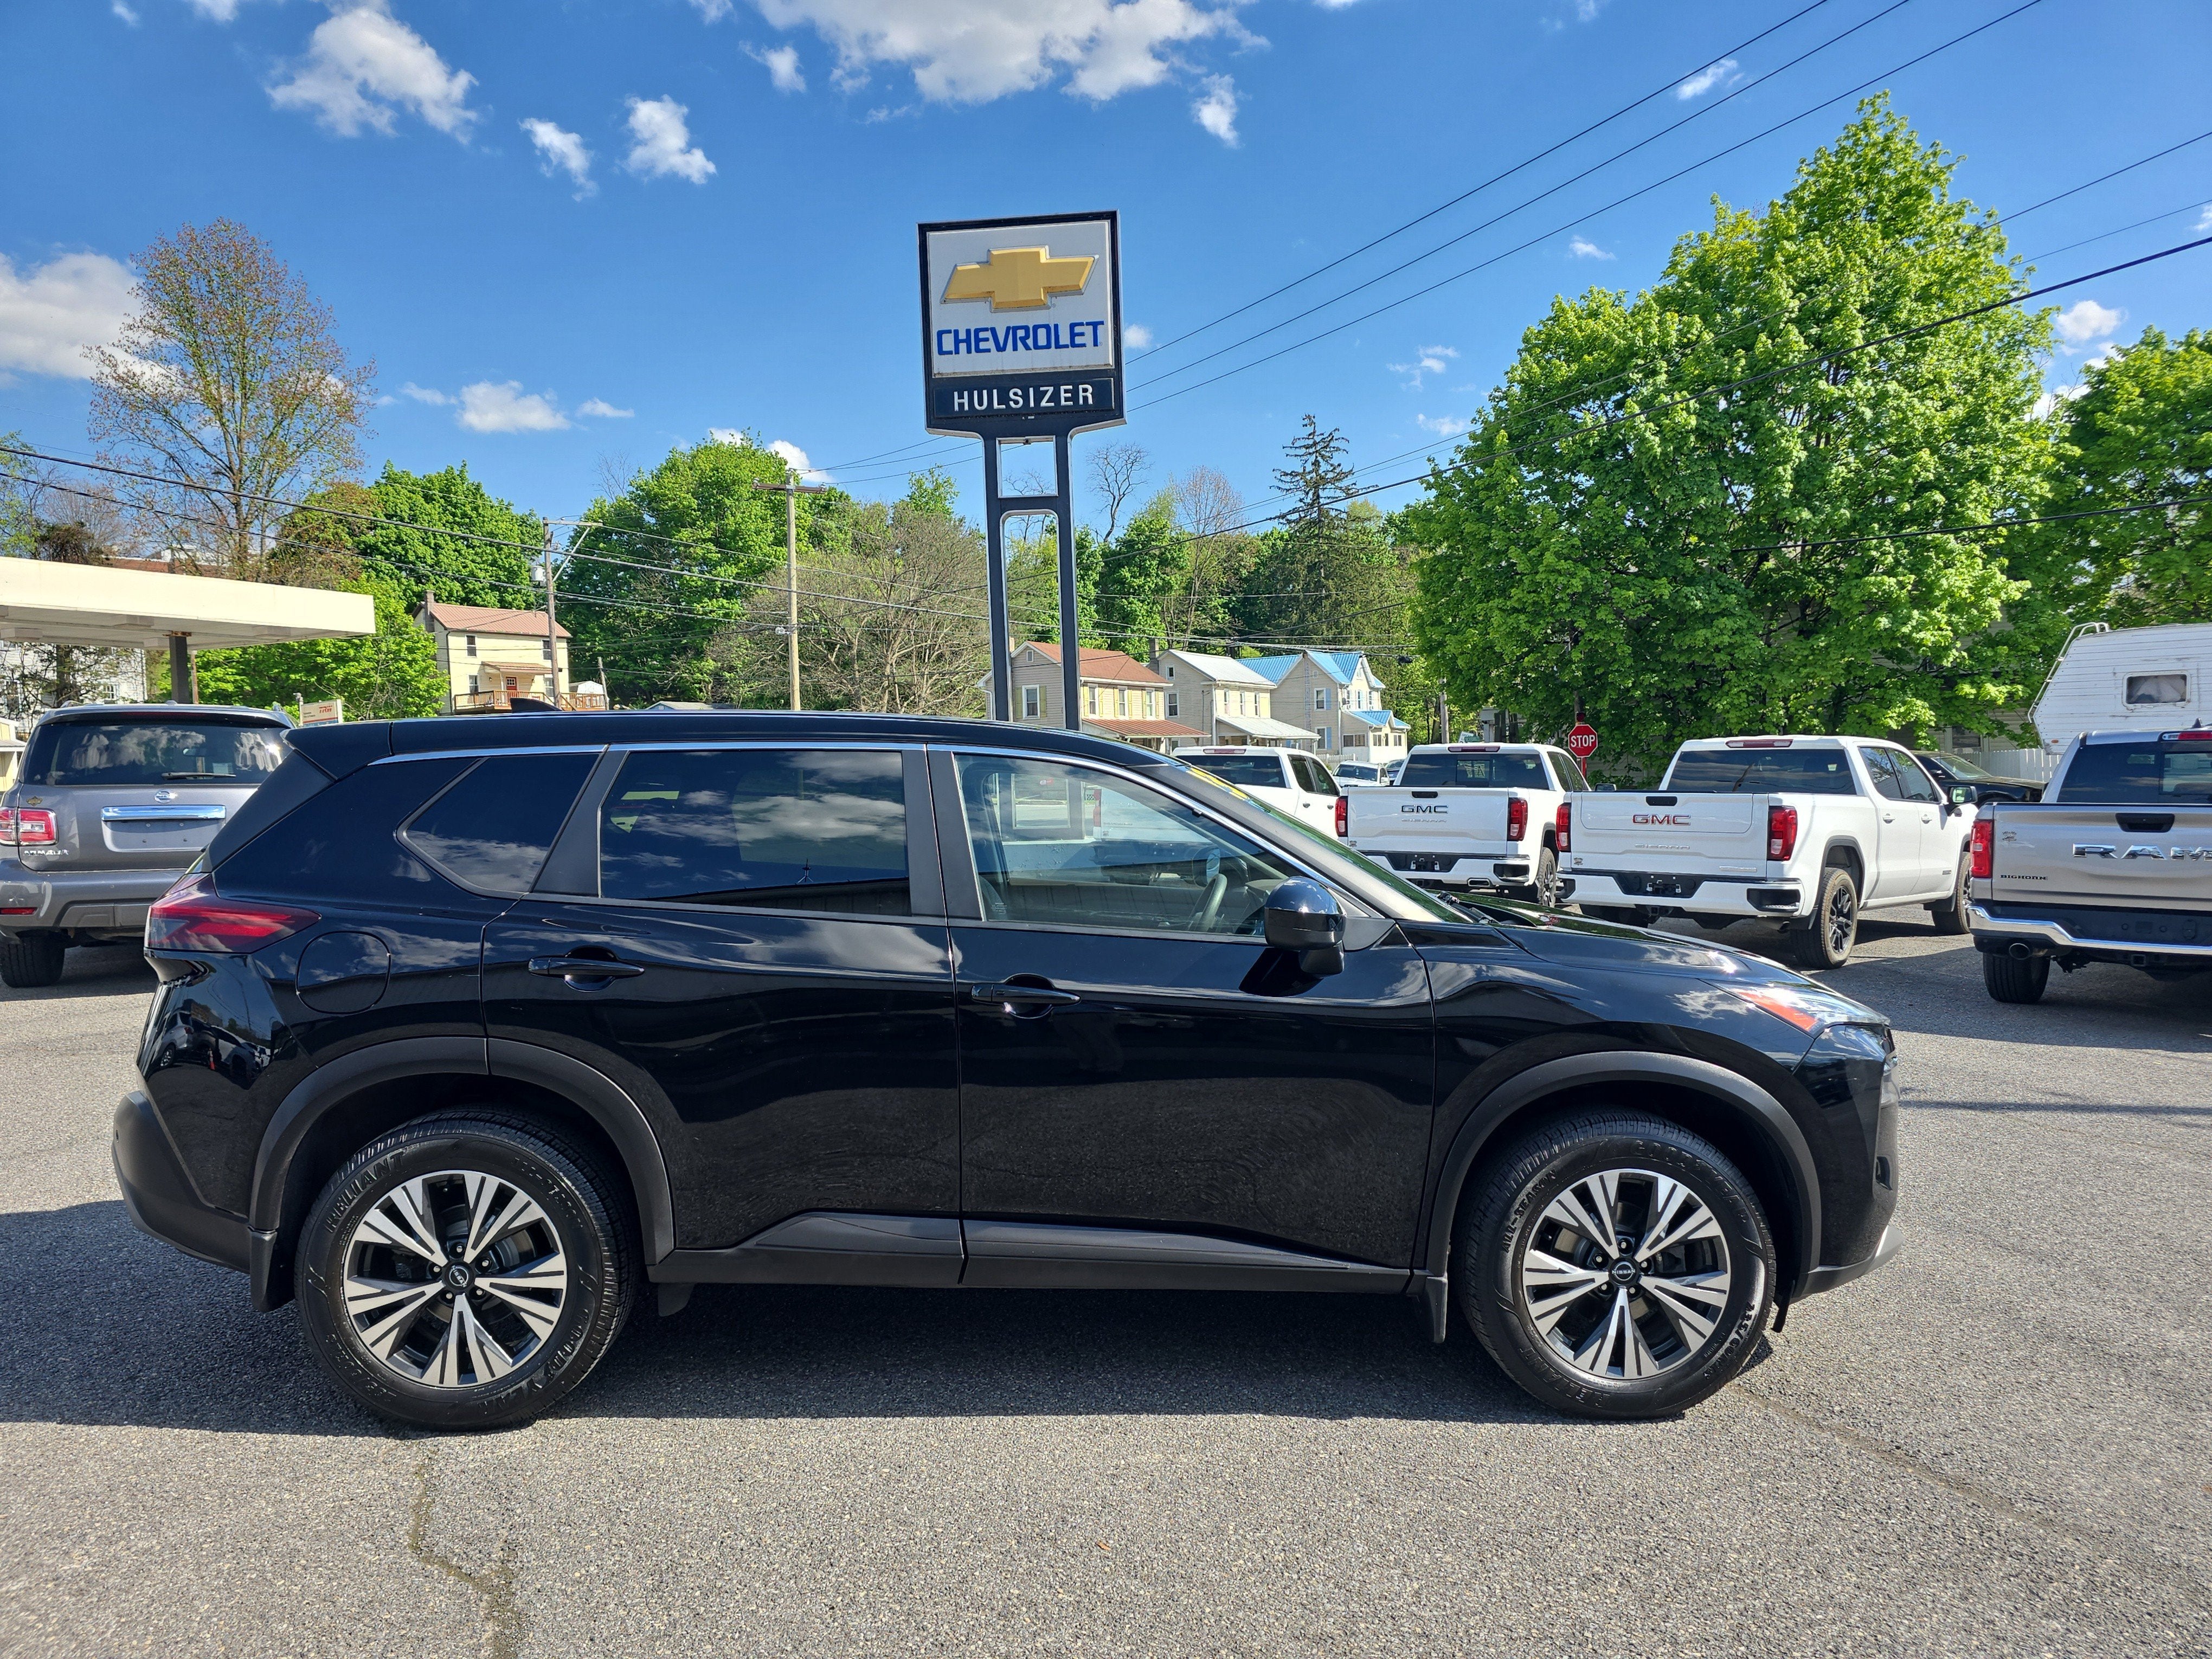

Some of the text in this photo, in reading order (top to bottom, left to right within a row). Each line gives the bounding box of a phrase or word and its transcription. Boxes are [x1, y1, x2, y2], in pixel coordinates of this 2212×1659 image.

[937, 320, 1104, 356] CHEVROLET
[954, 384, 1094, 411] HULSIZER
[1571, 735, 1596, 748] STOP
[1401, 805, 1449, 814] GMC
[1632, 813, 1692, 826] GMC
[2073, 843, 2212, 861] RAM
[325, 1150, 404, 1233] RELIANT
[1502, 1169, 1557, 1253] ALL-SEASON
[451, 1265, 467, 1288] NISSAN
